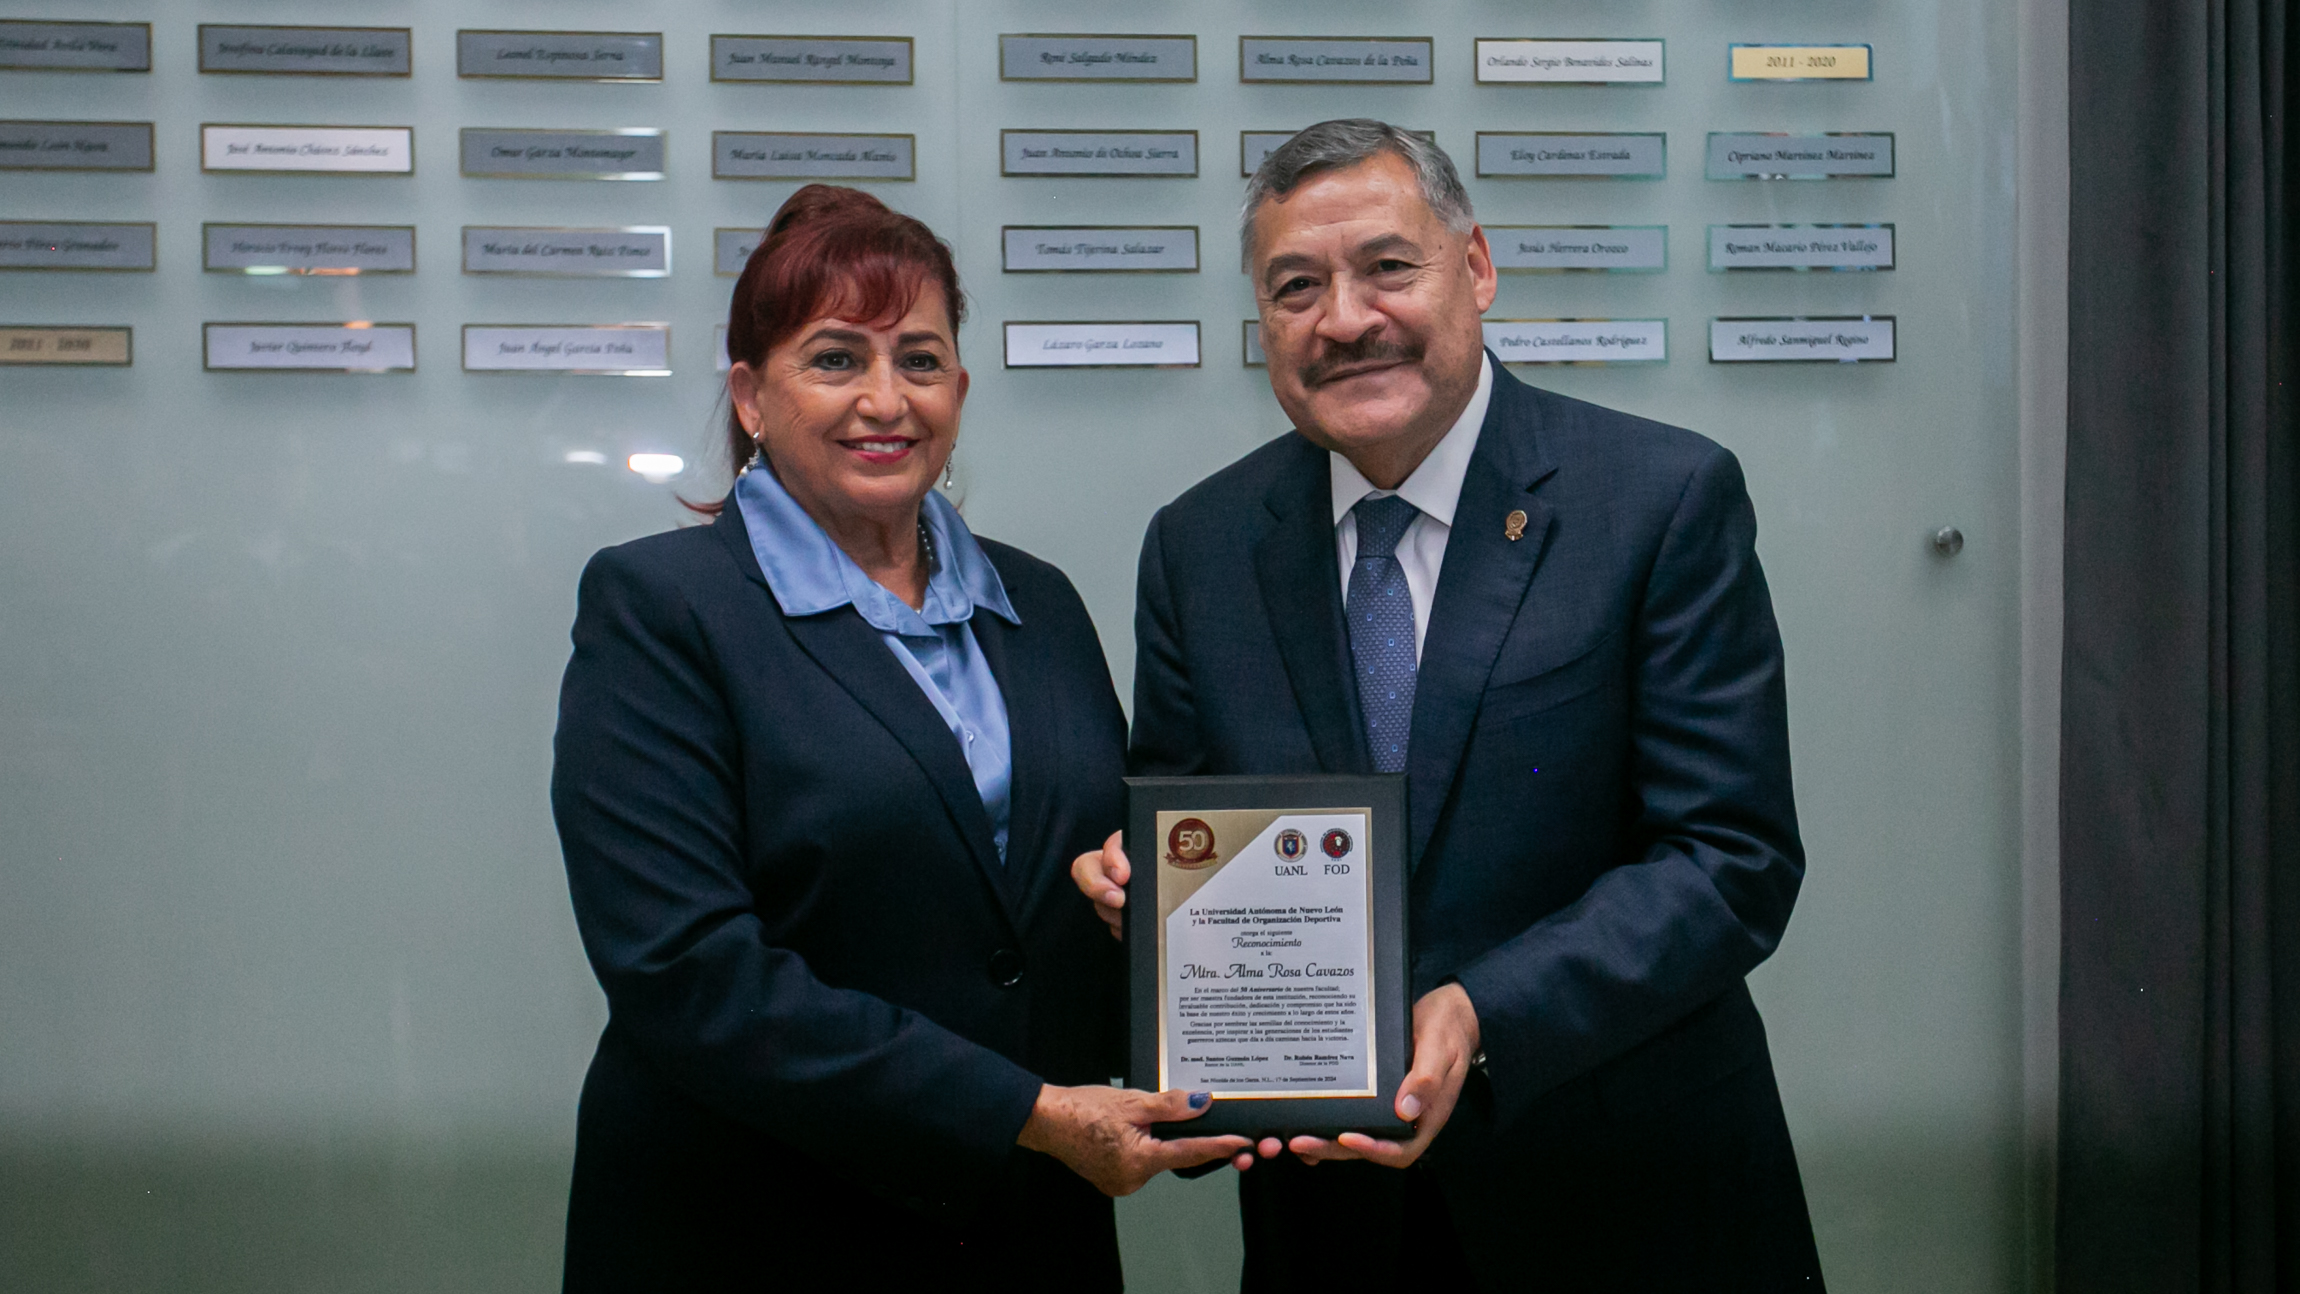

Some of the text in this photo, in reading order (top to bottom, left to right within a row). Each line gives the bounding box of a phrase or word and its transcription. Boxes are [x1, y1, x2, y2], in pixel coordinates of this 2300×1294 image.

[727, 52, 754, 65] Juan
[1287, 54, 1314, 66] Rosa
[1316, 54, 1360, 66] Cavazos
[1364, 54, 1374, 66] de
[1378, 54, 1388, 66] la
[1486, 56, 1528, 66] Orlando
[1530, 56, 1561, 70] Sergio
[1615, 56, 1652, 68] Salinas
[1766, 56, 1794, 67] 2011
[1807, 56, 1836, 68] 2020
[1510, 148, 1534, 164] Eloy
[1121, 243, 1164, 255] Salazar
[1548, 242, 1589, 253] Herrera
[1763, 242, 1807, 252] Macario
[1840, 240, 1878, 254] Vallejo
[1500, 335, 1531, 347] Pedro
[1532, 335, 1592, 348] Castellanos
[1737, 333, 1776, 348] Alfredo
[1179, 830, 1205, 851] 50
[1275, 866, 1308, 876] UANL
[1324, 864, 1350, 874] FOD
[1252, 916, 1302, 925] Organización
[1304, 915, 1341, 924] Deportiva
[1232, 936, 1302, 948] Reconocimiento
[1180, 963, 1354, 979] Mtra. Alma Rosa Cavazos
